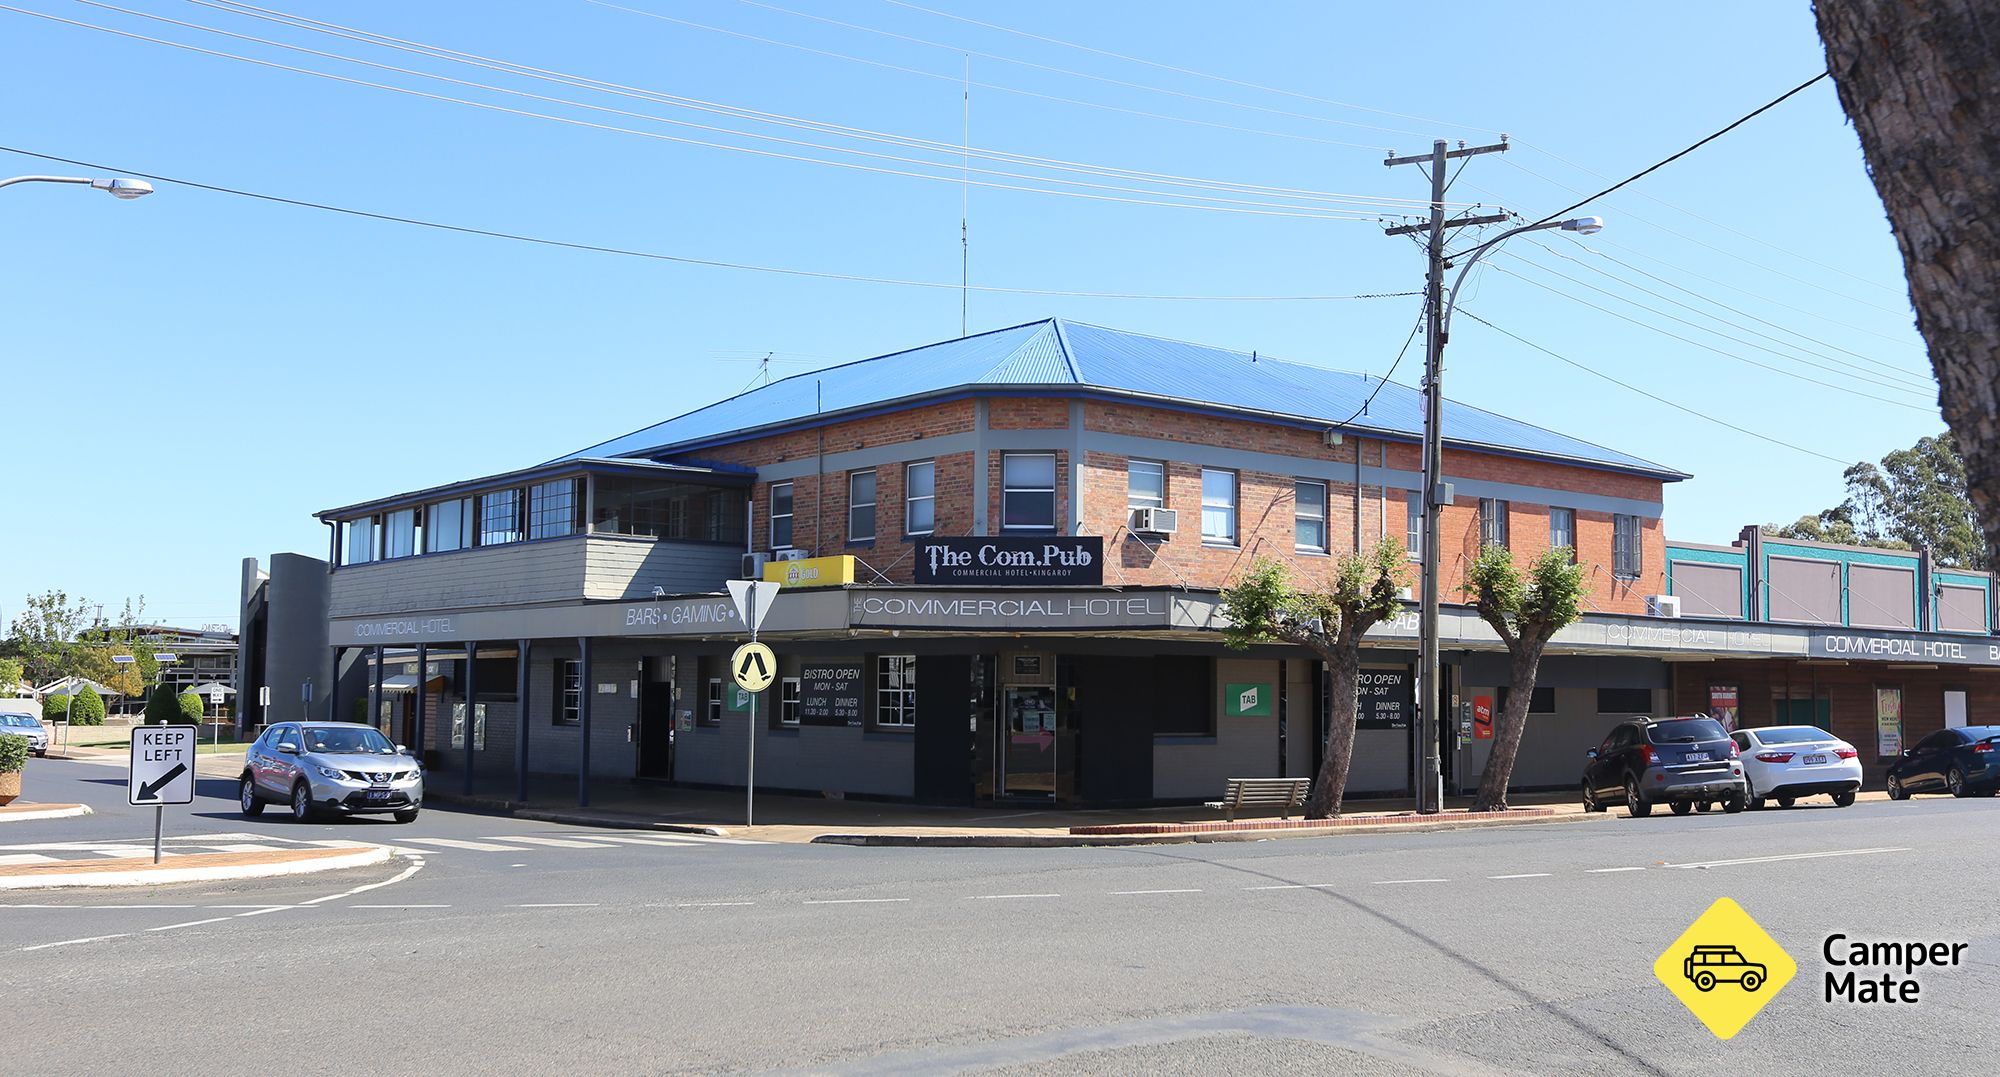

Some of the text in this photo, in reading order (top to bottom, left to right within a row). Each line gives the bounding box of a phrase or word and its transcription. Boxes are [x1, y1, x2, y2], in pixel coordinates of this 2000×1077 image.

[925, 544, 1092, 576] The Com.Pub
[800, 567, 819, 580] GOLD
[853, 597, 862, 613] THE
[863, 597, 1165, 616] COMMERCIAL HOTEL
[626, 603, 727, 626] BARS GAMING
[357, 622, 419, 637] COMMERCIAL
[421, 618, 455, 634] HOTEL
[1607, 624, 1715, 645] COMMERCIAL
[1825, 635, 1966, 659] COMMERCIAL HOTEL
[1989, 645, 2000, 661] B
[803, 669, 860, 680] BISTRO OPEN
[1374, 674, 1402, 685] OPEN
[813, 682, 831, 691] MON
[835, 682, 849, 691] SAT
[1374, 687, 1389, 696] SAT
[738, 690, 749, 700] TAB
[1241, 695, 1256, 704] TAB
[806, 697, 858, 707] LUNCH DINNER
[1375, 702, 1400, 711] DINNER
[1476, 705, 1490, 716] atm
[143, 733, 185, 745] KEEP
[144, 749, 183, 761] LEFT
